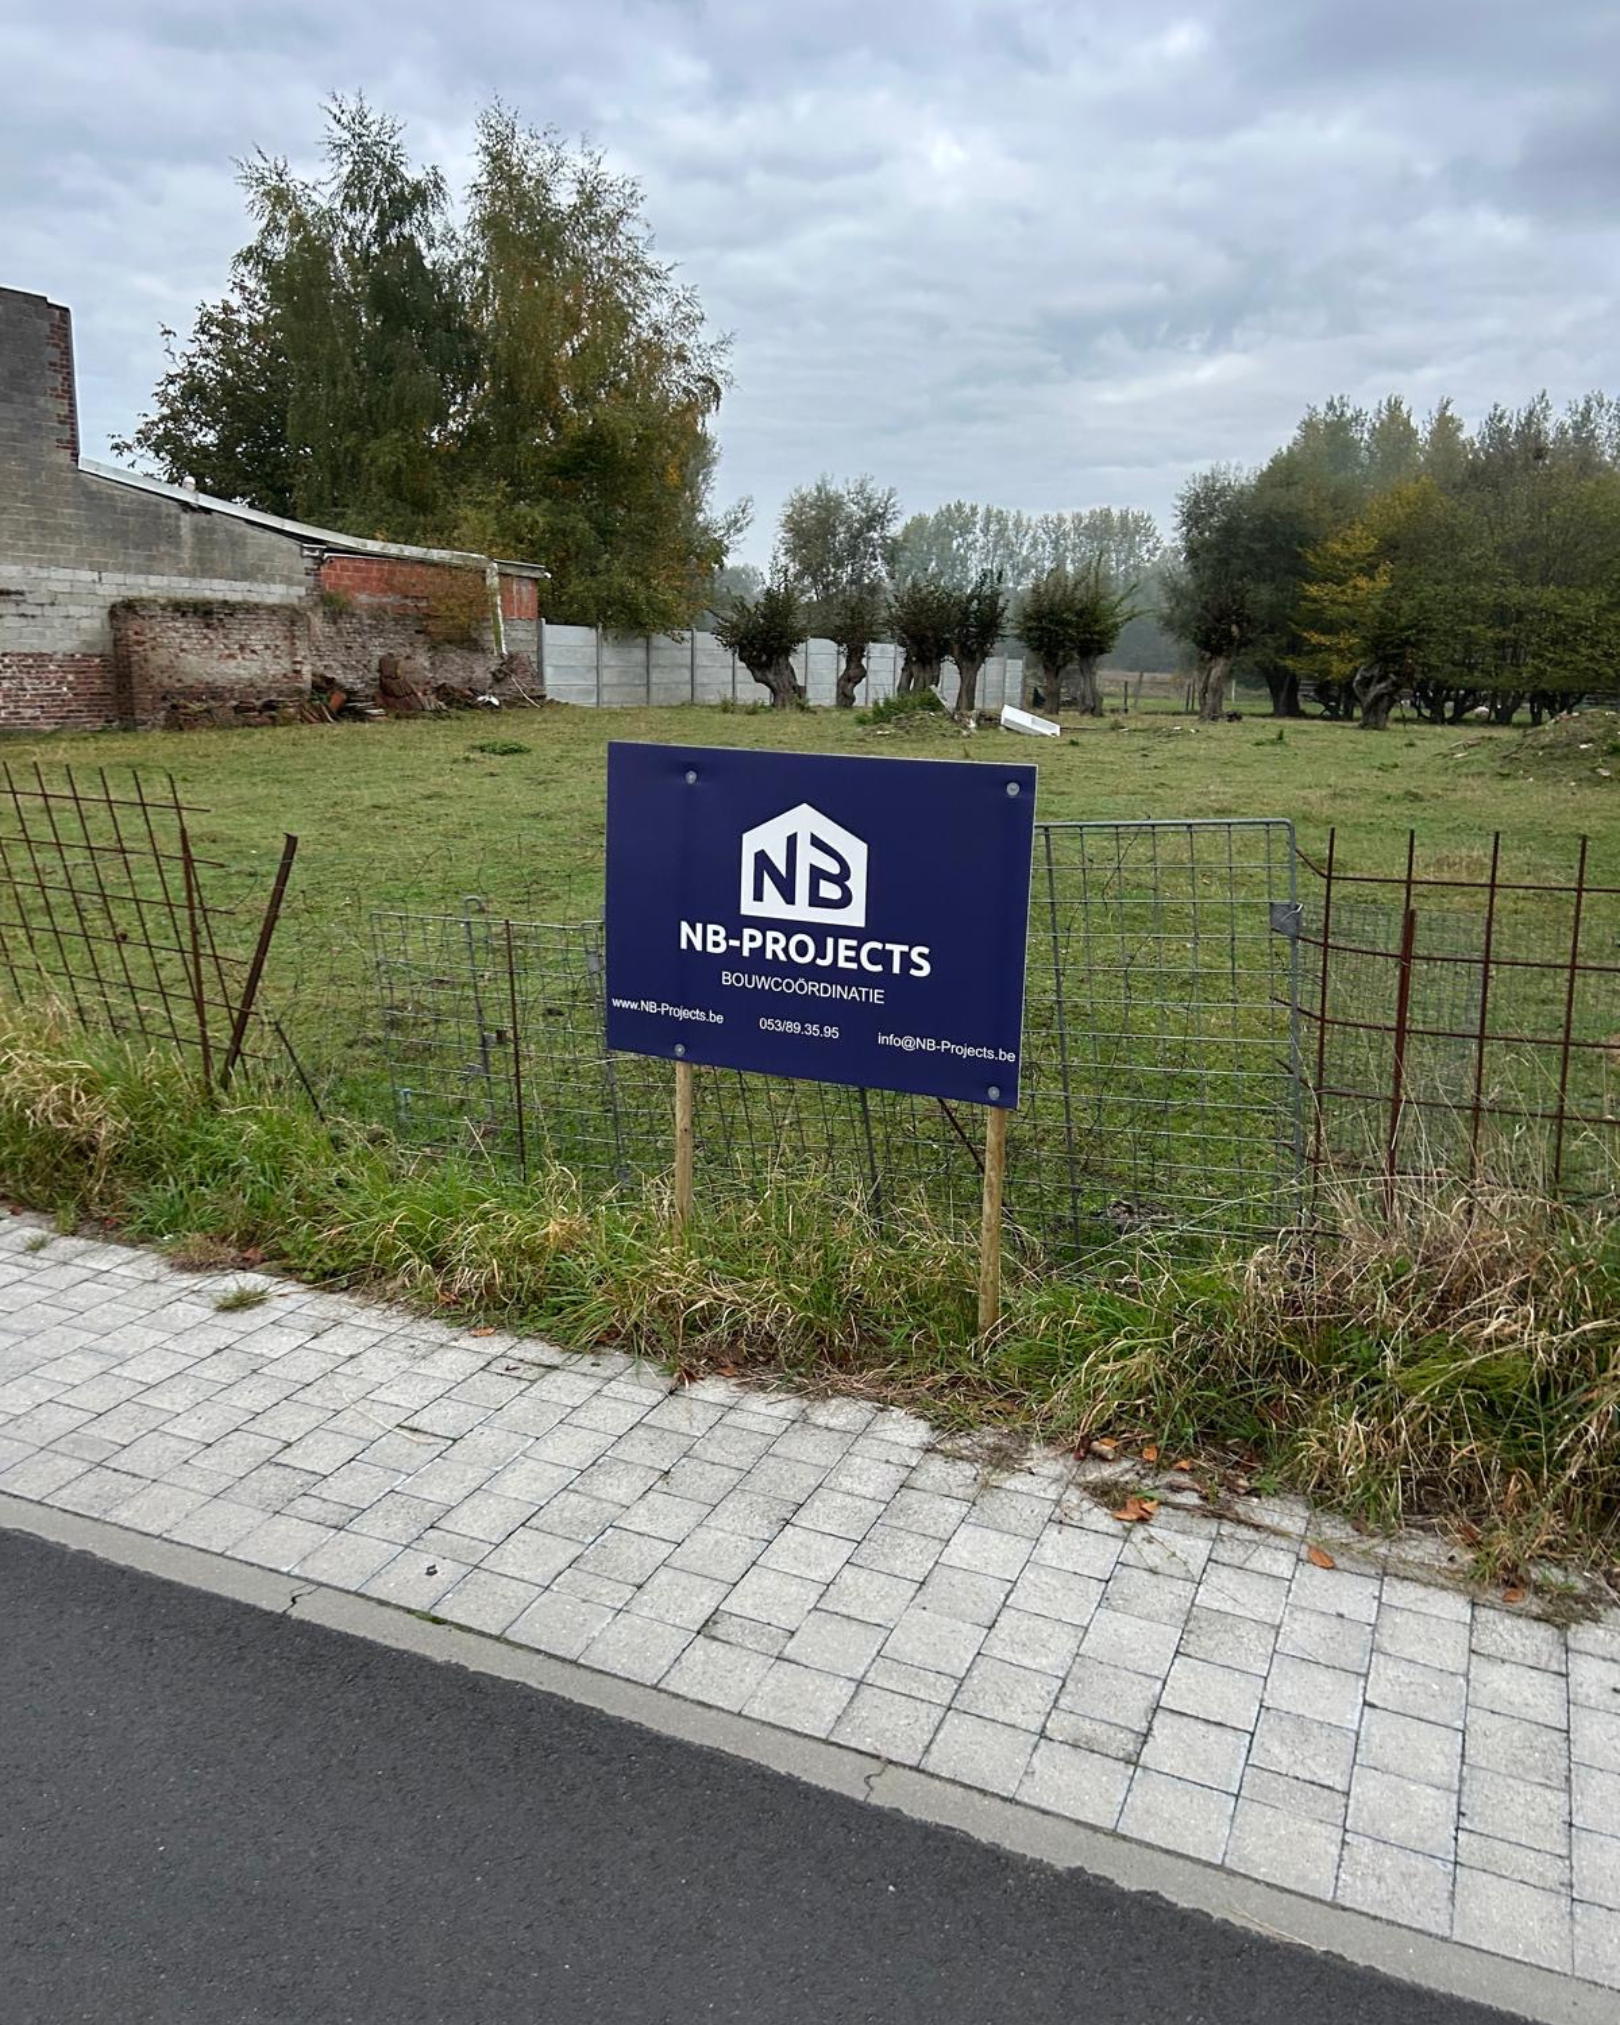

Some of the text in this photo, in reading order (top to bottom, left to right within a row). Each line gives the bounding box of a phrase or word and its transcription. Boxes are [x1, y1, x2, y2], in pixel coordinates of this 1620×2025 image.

[752, 831, 854, 910] NB
[679, 920, 931, 978] NB-PROJECTS
[721, 970, 885, 1004] BOUWCOÖRDINATIE
[611, 997, 724, 1024] www.NB-Projects.be
[759, 1017, 840, 1039] 053/89.35.95
[877, 1032, 1016, 1062] info@NB-Projects.be
